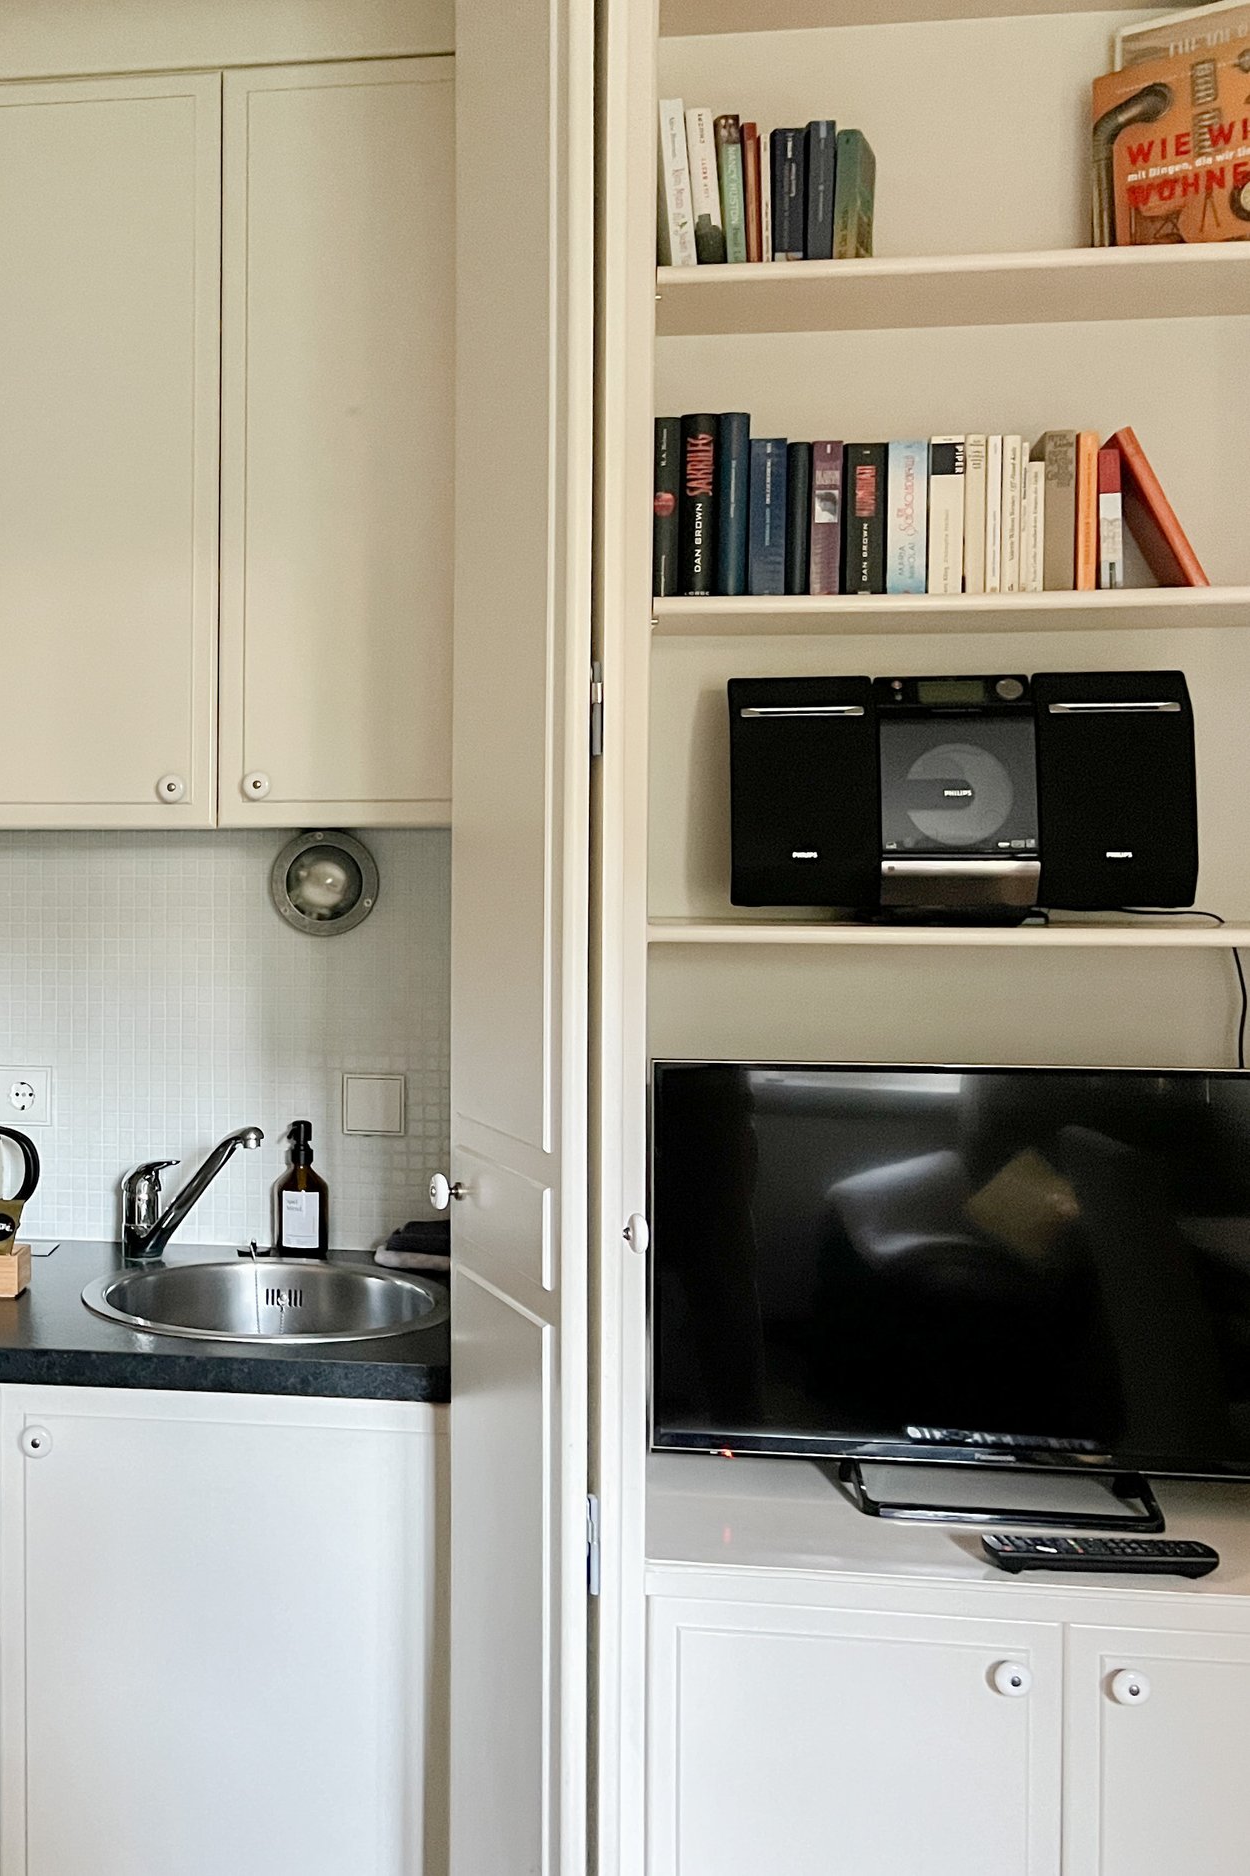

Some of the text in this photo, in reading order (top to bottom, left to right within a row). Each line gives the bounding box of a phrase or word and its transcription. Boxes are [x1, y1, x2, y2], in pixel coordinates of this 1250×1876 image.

[1126, 117, 1250, 166] WIE WI
[686, 433, 714, 497] SAKRILEG
[955, 445, 964, 474] PIPER
[694, 502, 703, 573] DAN BROWN
